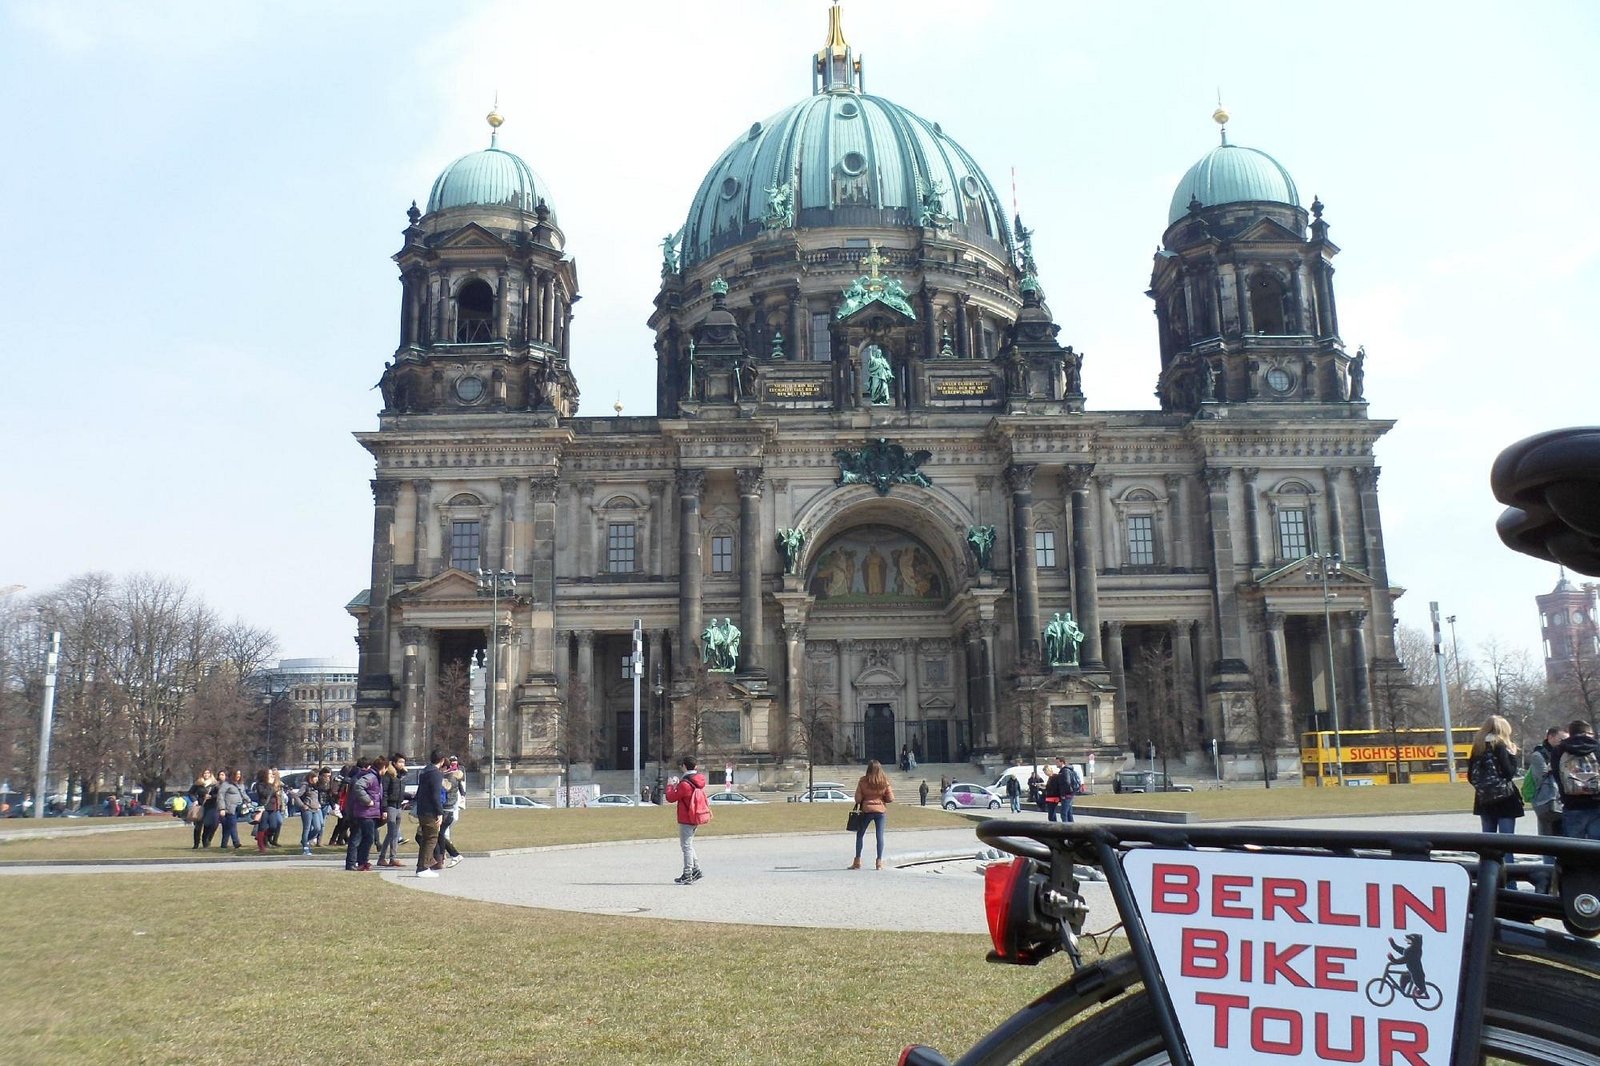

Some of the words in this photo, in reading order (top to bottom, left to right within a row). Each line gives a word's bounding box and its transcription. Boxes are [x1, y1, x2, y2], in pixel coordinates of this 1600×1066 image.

[1350, 746, 1436, 760] SIGHTSEEING
[1151, 863, 1447, 933] BERLIN
[1181, 927, 1359, 992] BIKE
[1195, 991, 1431, 1066] TOUR
